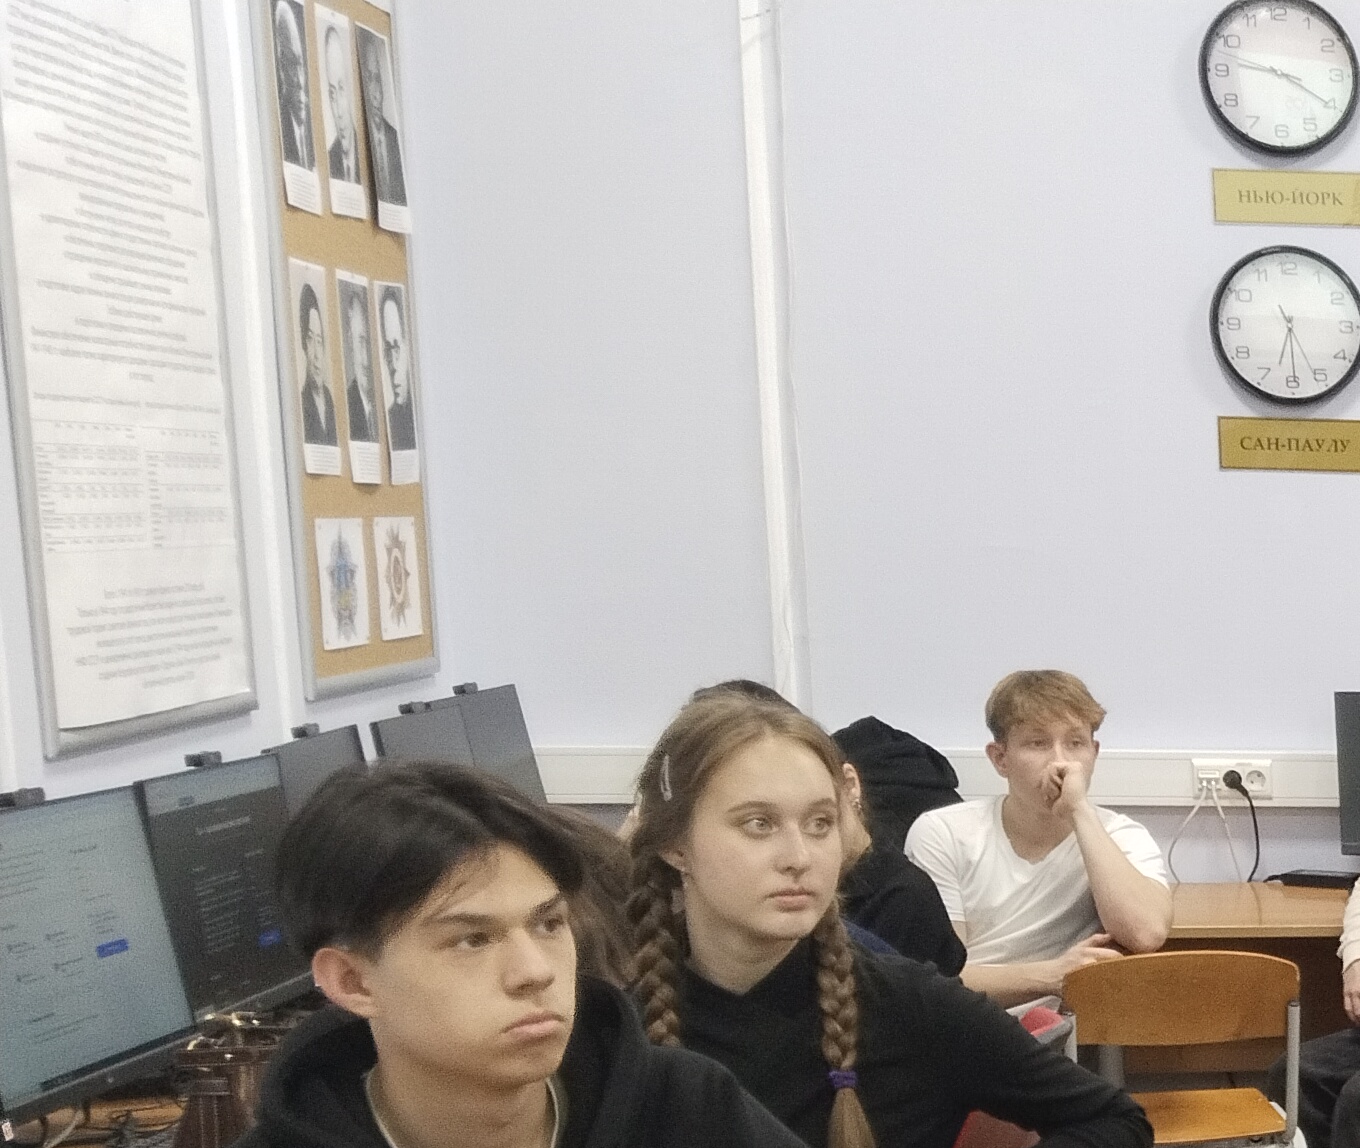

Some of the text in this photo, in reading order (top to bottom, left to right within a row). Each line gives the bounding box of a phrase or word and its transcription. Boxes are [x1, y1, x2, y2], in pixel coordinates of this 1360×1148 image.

[1242, 13, 1257, 28] 11
[1268, 7, 1287, 21] 12
[1303, 17, 1310, 30] 1
[1219, 34, 1241, 48] 10
[1320, 38, 1335, 53] 2
[1215, 63, 1229, 77] 9
[1329, 68, 1344, 82] 3
[1223, 92, 1239, 107] 8
[1323, 98, 1336, 110] 4
[1245, 115, 1260, 127] 7
[1302, 117, 1317, 131] 5
[1274, 123, 1289, 137] 6
[1238, 188, 1343, 206] НЬЮ-ЙОРК
[1253, 268, 1268, 282] 11
[1279, 261, 1298, 276] 12
[1313, 270, 1320, 284] 1
[1231, 289, 1252, 303] 10
[1330, 291, 1345, 306] 2
[1226, 317, 1241, 331] 9
[1339, 320, 1353, 334] 3
[1235, 345, 1250, 359] 8
[1333, 349, 1347, 360] 4
[1257, 366, 1271, 380] 7
[1313, 368, 1327, 382] 5
[1285, 375, 1300, 388] 6
[1240, 436, 1350, 453] САН-ПАУЛУ
